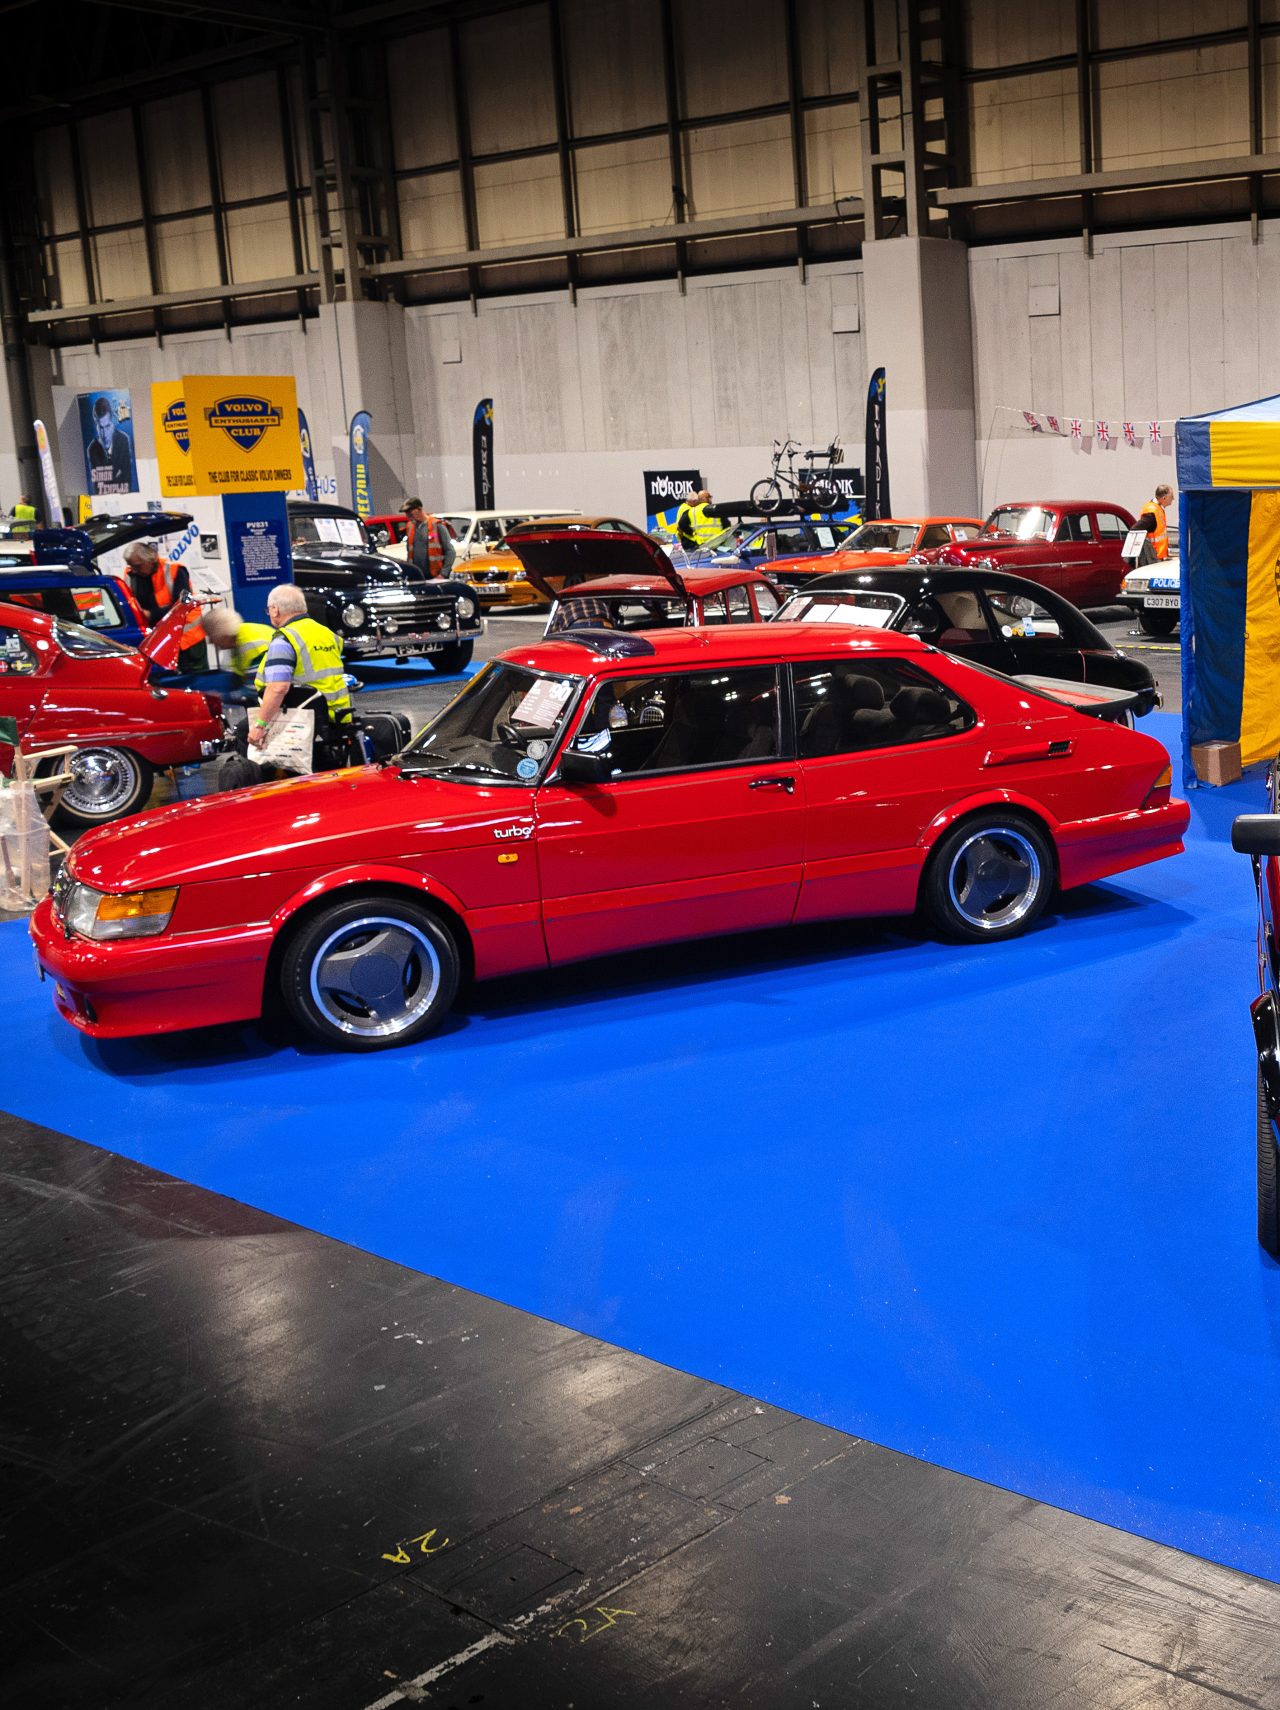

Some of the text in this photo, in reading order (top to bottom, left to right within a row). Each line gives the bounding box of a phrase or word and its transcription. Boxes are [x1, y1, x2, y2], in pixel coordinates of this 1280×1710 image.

[225, 404, 262, 412] VOLVO
[230, 428, 261, 437] CLUB
[1152, 578, 1180, 588] POLICE
[493, 824, 532, 838] turbo
